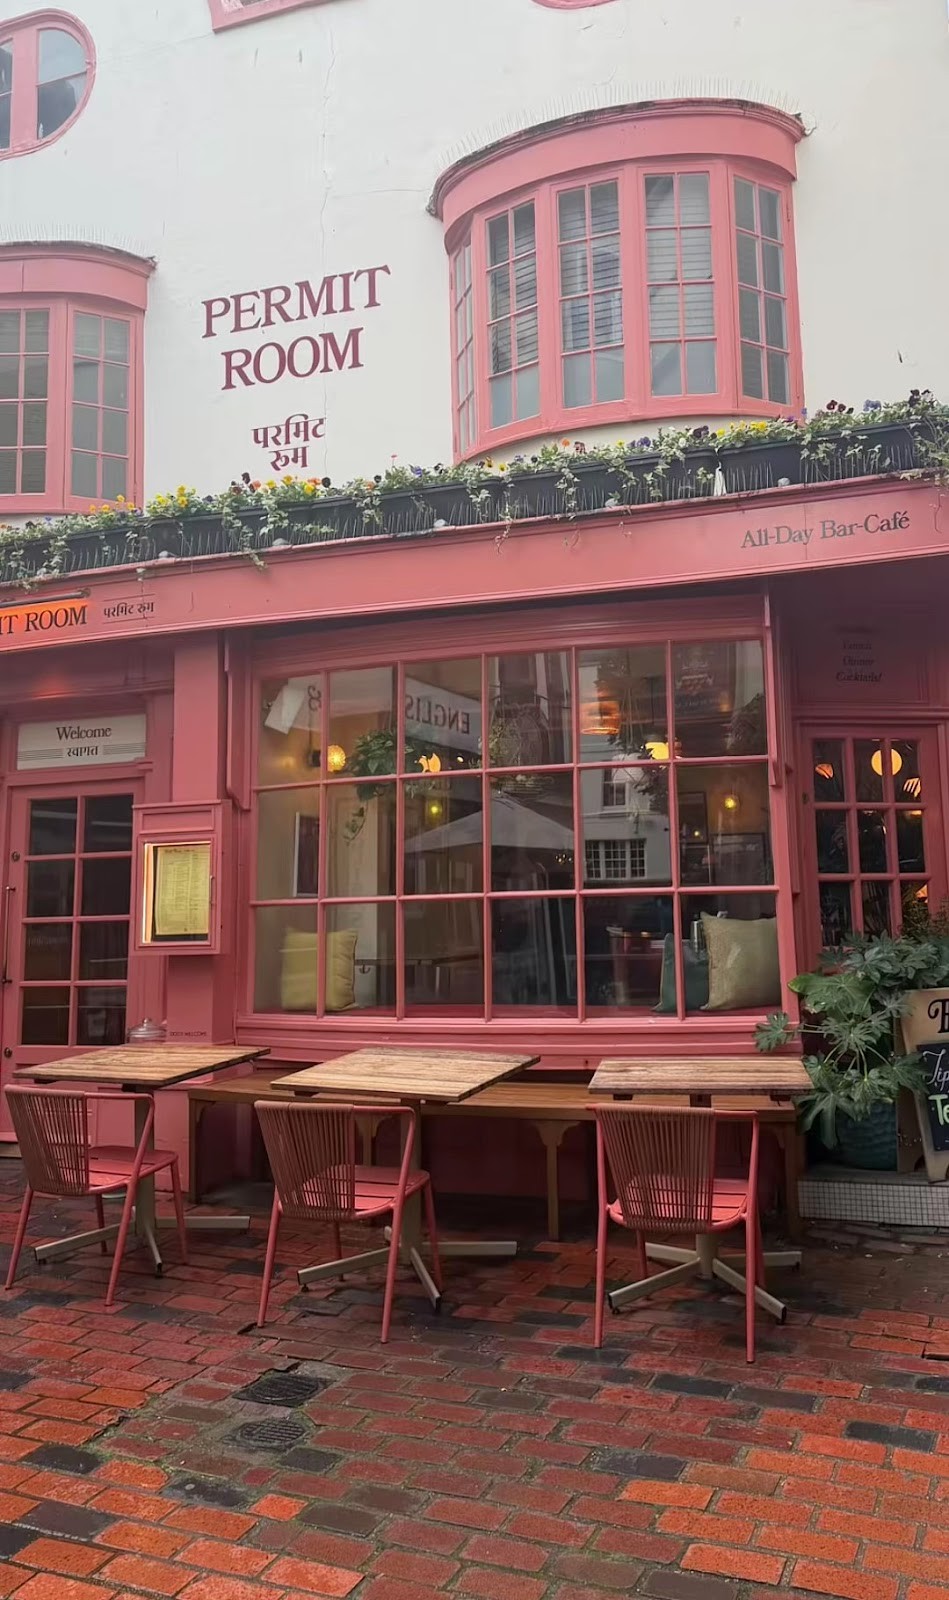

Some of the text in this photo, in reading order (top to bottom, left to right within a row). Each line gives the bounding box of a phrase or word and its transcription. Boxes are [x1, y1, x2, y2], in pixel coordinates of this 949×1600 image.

[201, 264, 391, 339] PERMIT
[221, 327, 364, 391] ROOM
[251, 413, 326, 448] परमिट
[269, 445, 309, 471] रूम
[740, 510, 910, 549] All-Day Bar-Café
[24, 604, 88, 632] ROOM
[103, 601, 134, 618] परमिट
[56, 725, 112, 741] Welcome
